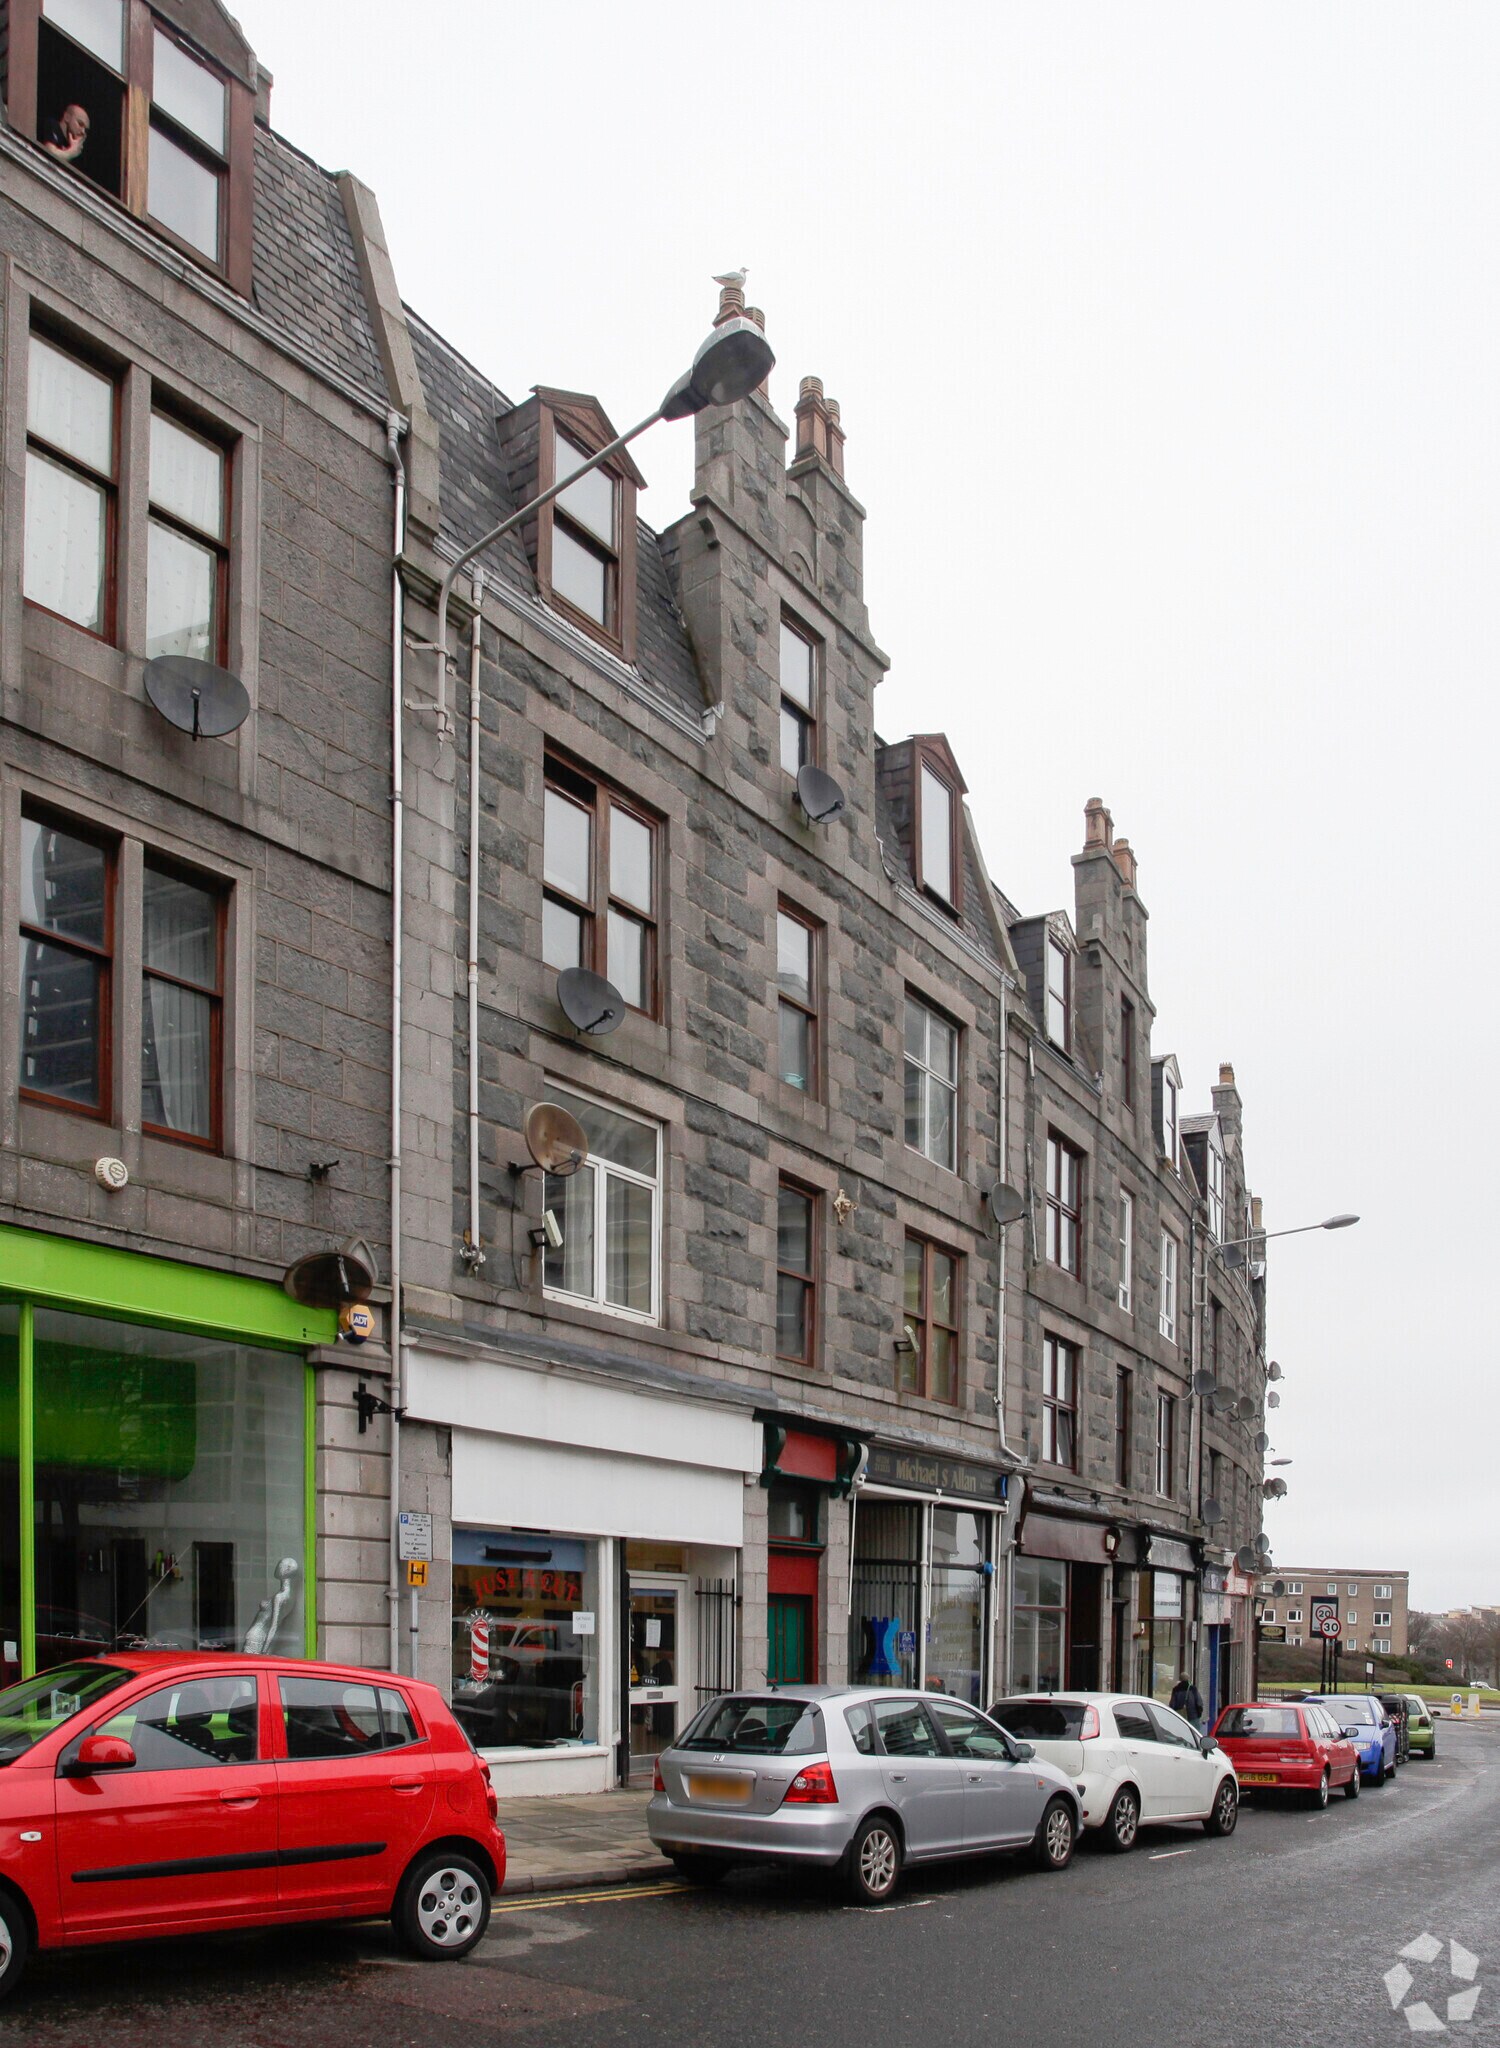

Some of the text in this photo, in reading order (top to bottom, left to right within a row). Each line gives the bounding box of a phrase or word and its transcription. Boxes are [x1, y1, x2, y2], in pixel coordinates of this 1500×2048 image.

[353, 1315, 367, 1326] ADT
[896, 1458, 939, 1486] Michael
[942, 1468, 949, 1488] S
[951, 1465, 977, 1492] Allan
[410, 1562, 425, 1583] H
[473, 1568, 578, 1606] JUST A CUT
[1318, 1610, 1331, 1618] 20
[1323, 1622, 1339, 1632] 30
[1257, 1774, 1274, 1782] GSA
